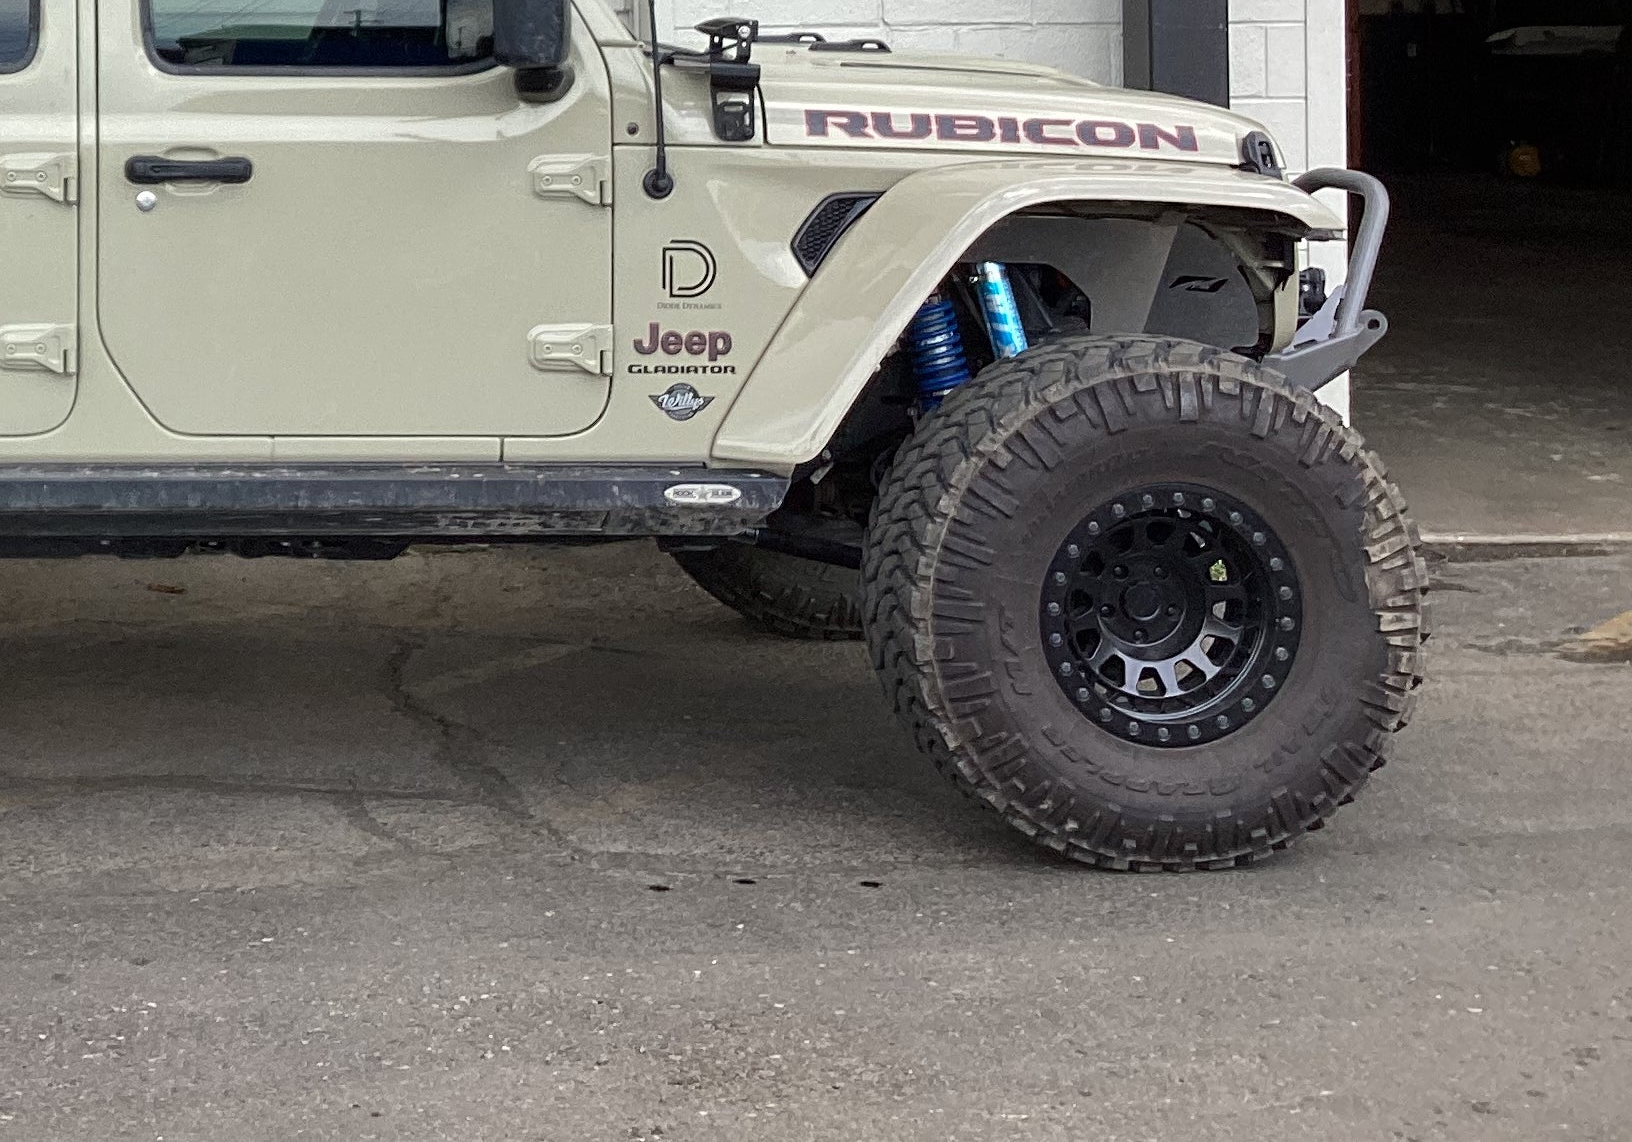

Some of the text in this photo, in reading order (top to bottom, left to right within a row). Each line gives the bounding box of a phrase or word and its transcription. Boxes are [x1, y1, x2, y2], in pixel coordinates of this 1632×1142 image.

[804, 108, 1199, 153] RUBICON
[632, 321, 733, 363] Jeep
[627, 363, 737, 375] GLADIATOR
[658, 392, 705, 411] Willys
